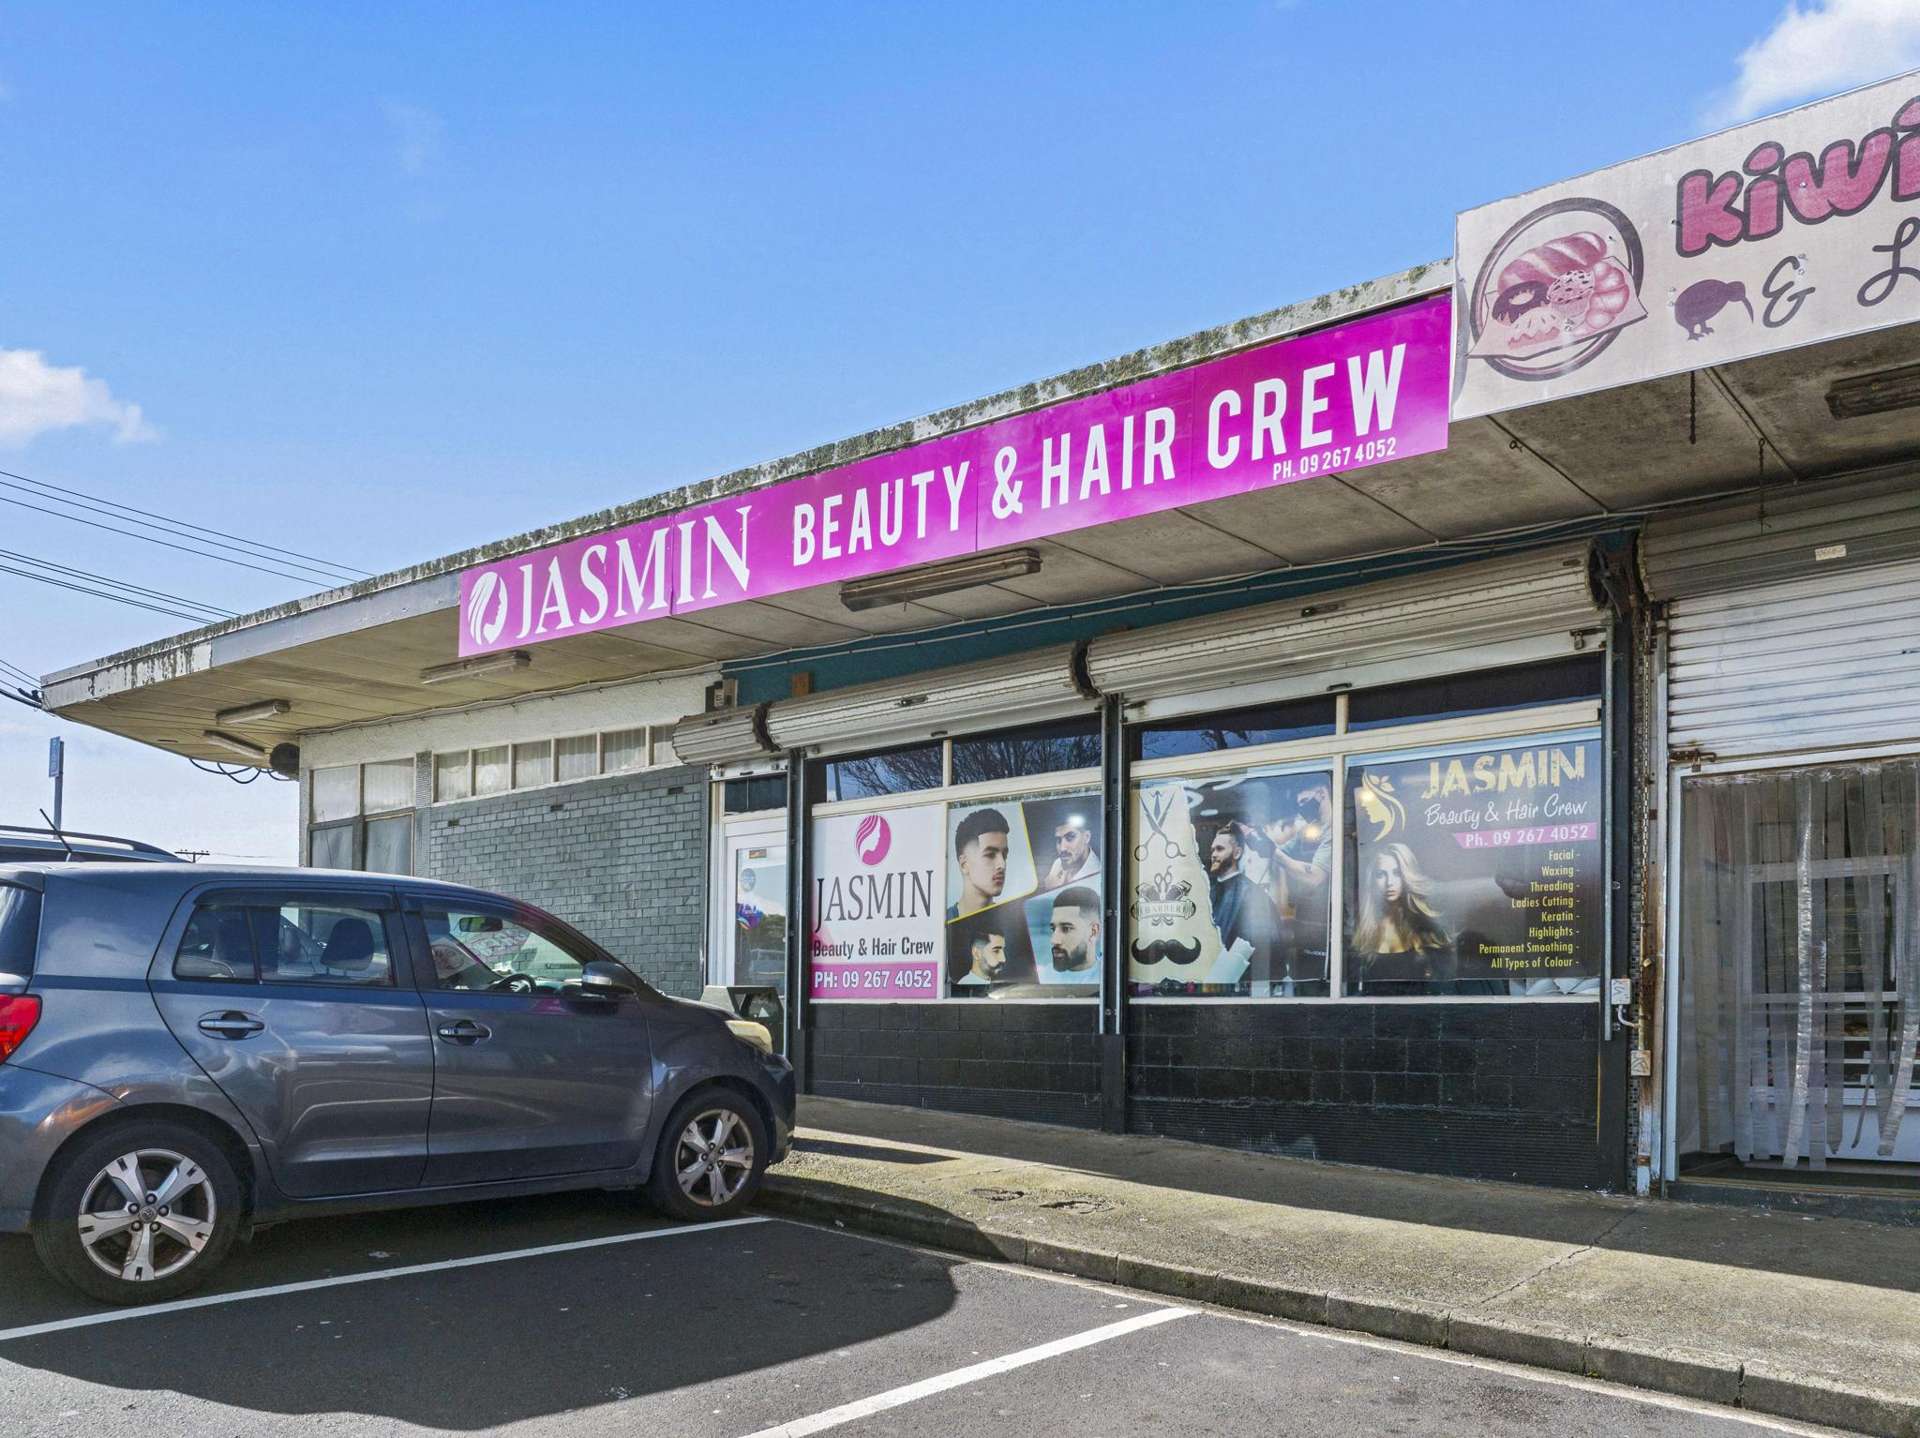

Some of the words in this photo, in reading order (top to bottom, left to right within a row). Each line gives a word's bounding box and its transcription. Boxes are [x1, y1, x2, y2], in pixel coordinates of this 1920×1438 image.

[1763, 255, 1815, 328] &
[1273, 462, 1296, 481] PH.
[1300, 453, 1319, 475] 09
[1322, 446, 1351, 471] 267
[1355, 436, 1396, 463] 4052
[516, 504, 753, 638] JASMIN
[793, 461, 969, 567] BEAUTY
[991, 446, 1023, 519] &
[1041, 406, 1176, 510] HAIR
[1207, 343, 1407, 469] CREW
[1421, 746, 1585, 800] JASMIN
[1424, 803, 1481, 830] Beauty
[1484, 801, 1500, 822] &
[1506, 801, 1540, 821] Hair
[1543, 793, 1588, 818] Crew
[1466, 833, 1488, 847] Ph.
[1493, 832, 1511, 845] 09
[1517, 829, 1545, 843] 267
[1550, 825, 1589, 841] 4052
[1549, 849, 1574, 861] Facial
[1541, 866, 1574, 877] Waxing
[1530, 881, 1574, 893] Threading
[814, 870, 934, 933] JASMIN
[1511, 897, 1540, 909] Ladies
[1542, 896, 1574, 908] Cutting
[1541, 912, 1574, 922] Keratin
[1529, 926, 1573, 940] Highlights
[814, 939, 854, 960] Beauty
[858, 937, 868, 956] &
[872, 937, 897, 956] Hair
[901, 936, 934, 955] Crew
[1479, 943, 1525, 954] Permanent
[1526, 942, 1574, 954] Smoothing
[1491, 957, 1502, 969] All
[1504, 957, 1529, 970] Types
[1531, 956, 1541, 968] of
[1544, 956, 1573, 968] Colour
[814, 970, 838, 988] PH:
[842, 970, 859, 987] 09
[863, 970, 890, 987] 267
[894, 969, 932, 988] 4052
